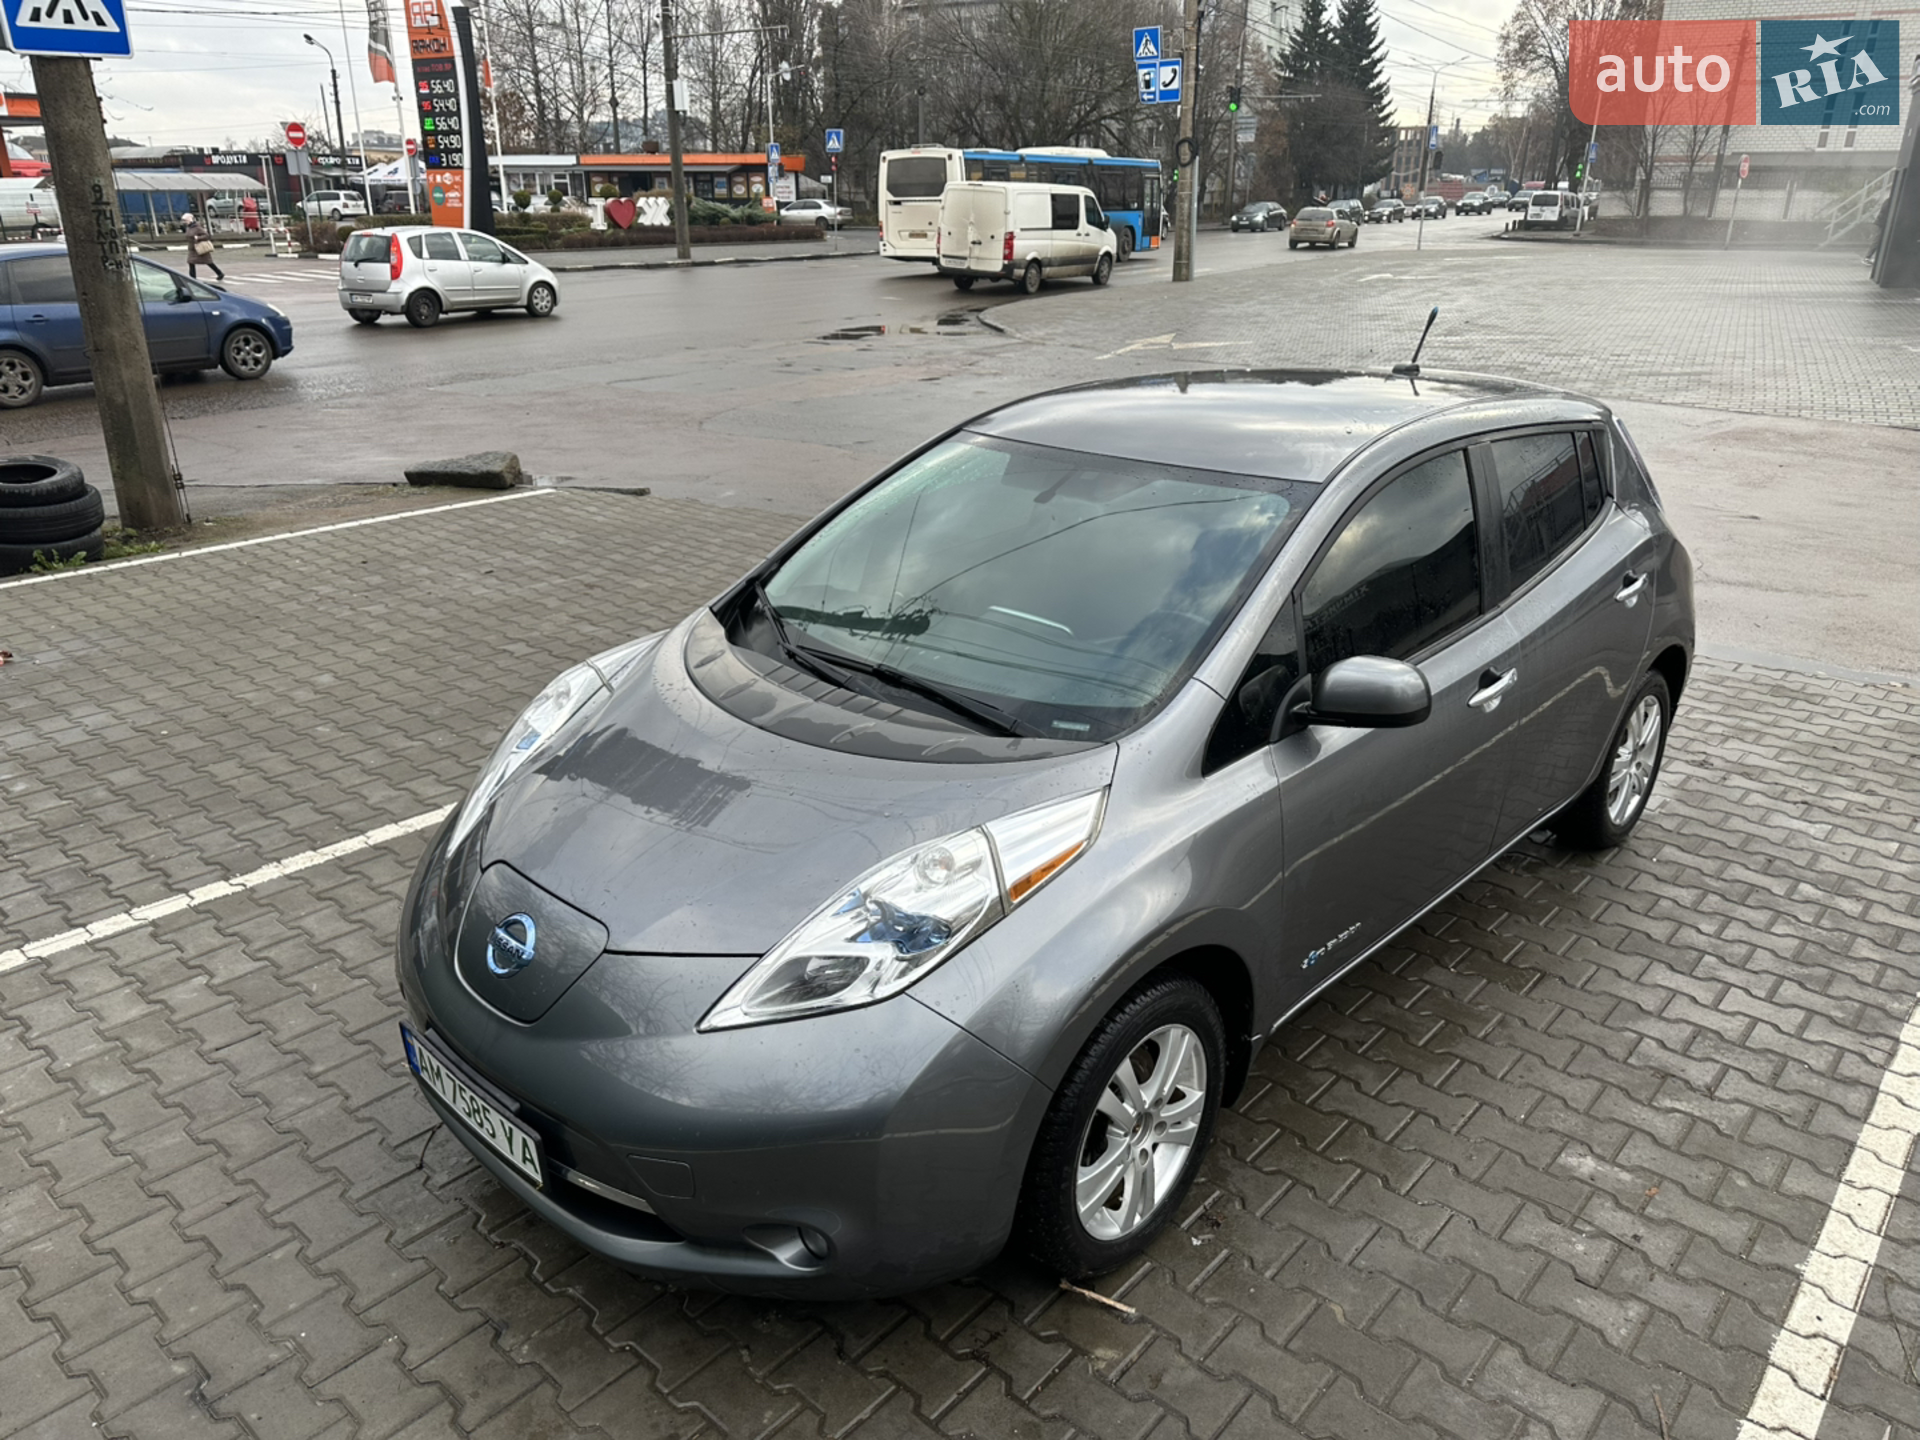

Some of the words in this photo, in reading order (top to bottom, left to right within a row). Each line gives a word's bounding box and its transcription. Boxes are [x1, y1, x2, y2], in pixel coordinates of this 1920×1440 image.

[417, 1046, 447, 1096] AM
[445, 1071, 497, 1139] 7585
[499, 1117, 540, 1175] YA
